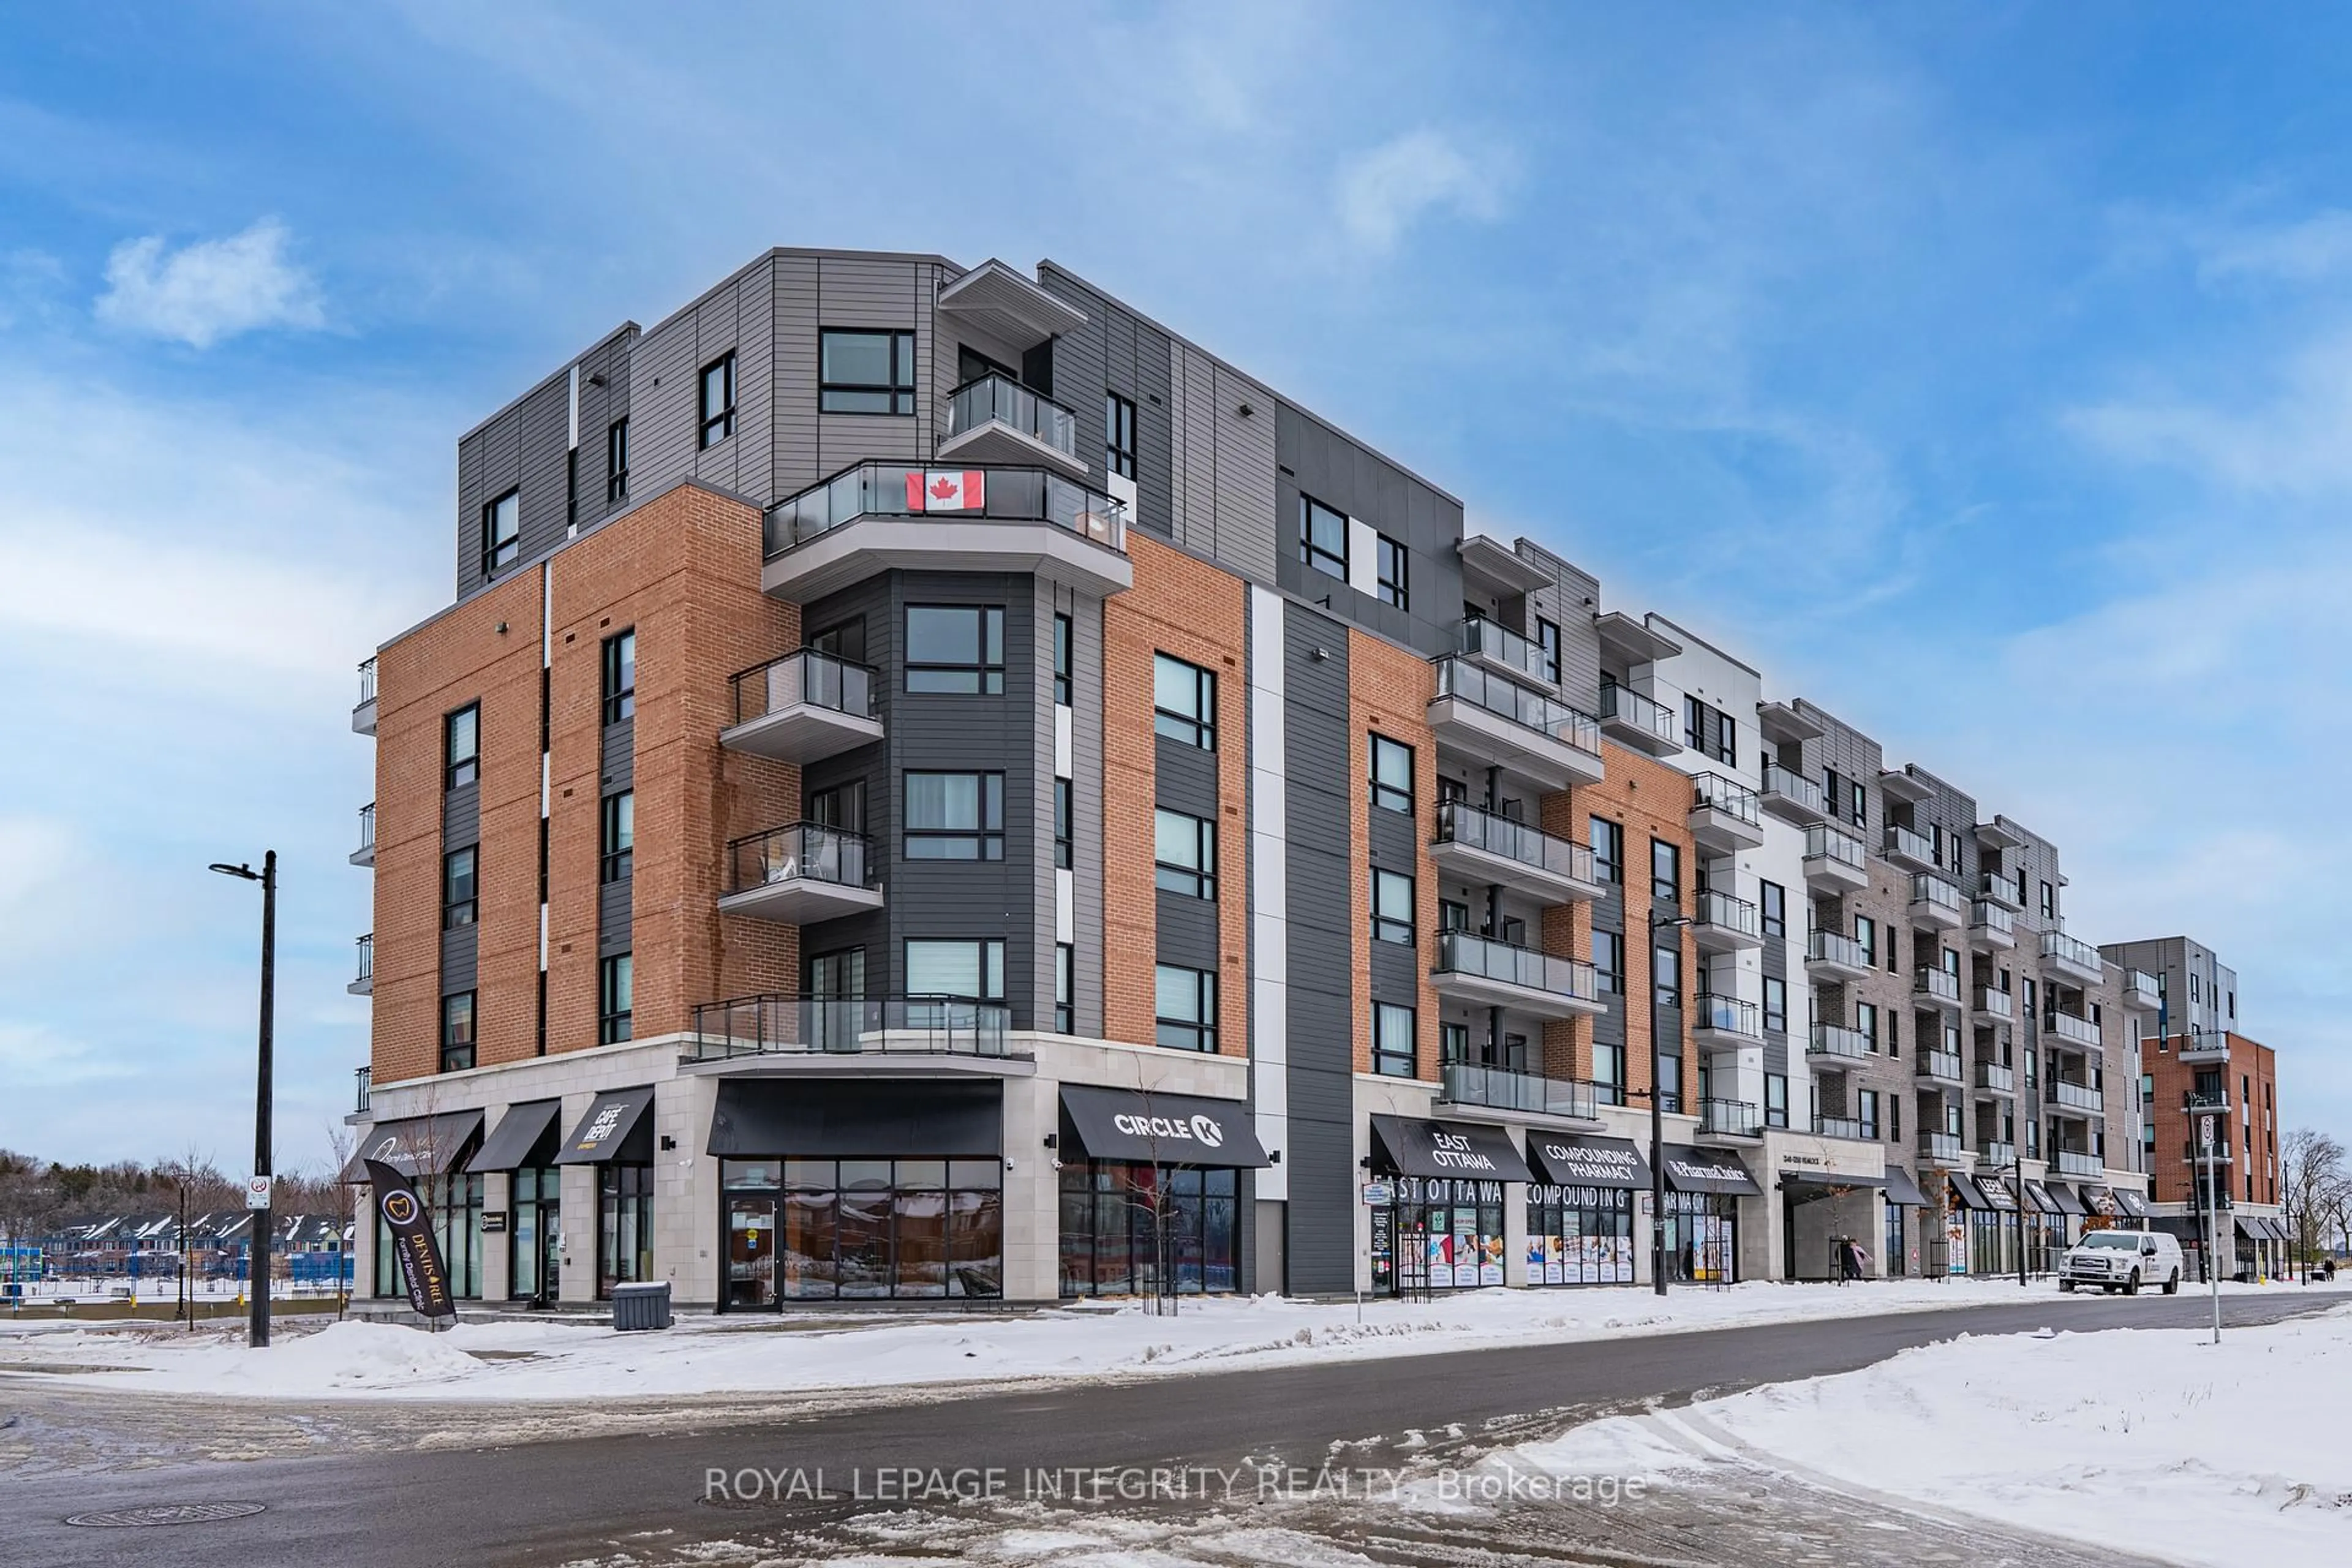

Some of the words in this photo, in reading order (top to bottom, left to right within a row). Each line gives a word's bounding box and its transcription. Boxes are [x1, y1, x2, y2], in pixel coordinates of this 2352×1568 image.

[1114, 1114, 1193, 1139] CIRCLE
[1433, 1133, 1471, 1151] EAST
[1433, 1150, 1496, 1170] OTTAWA
[1545, 1145, 1637, 1166] COMPOUNDING
[1568, 1163, 1635, 1180] PHARMACY
[1428, 1178, 1502, 1202] OTTAWA
[1526, 1184, 1624, 1207] COMPOUNDING
[405, 1263, 419, 1289] Dental
[413, 1289, 425, 1310] Clinic
